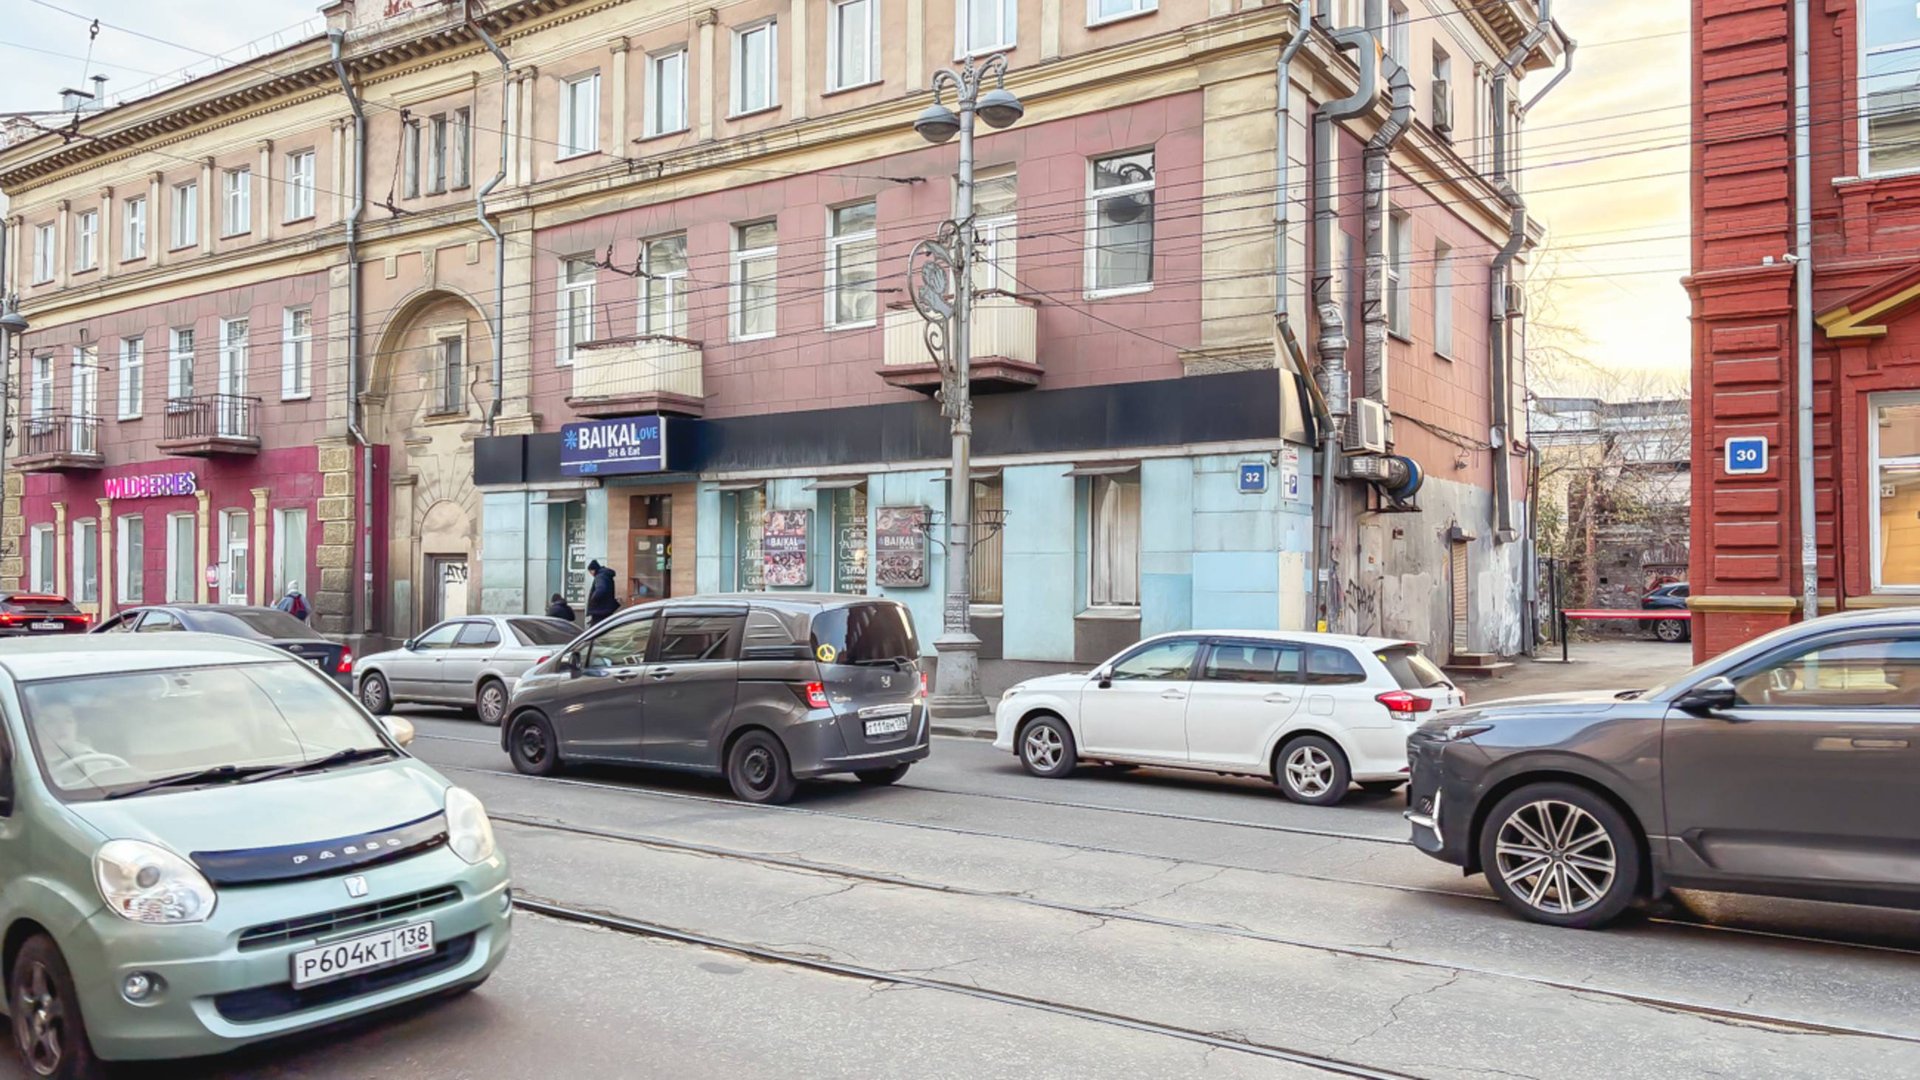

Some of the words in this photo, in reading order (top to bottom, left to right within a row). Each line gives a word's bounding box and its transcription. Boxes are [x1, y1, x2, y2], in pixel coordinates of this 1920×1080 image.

[579, 424, 640, 450] BAIKAL
[608, 448, 618, 457] Sit
[628, 446, 640, 456] Eat
[1736, 449, 1757, 461] 30
[1245, 472, 1260, 483] 32
[104, 471, 196, 499] WILDBERRIES
[770, 537, 798, 547] BAIKAL
[884, 536, 915, 546] BAIKAL
[292, 838, 401, 864] PASSO
[304, 940, 391, 977] Р604КТ
[397, 926, 428, 947] 138
